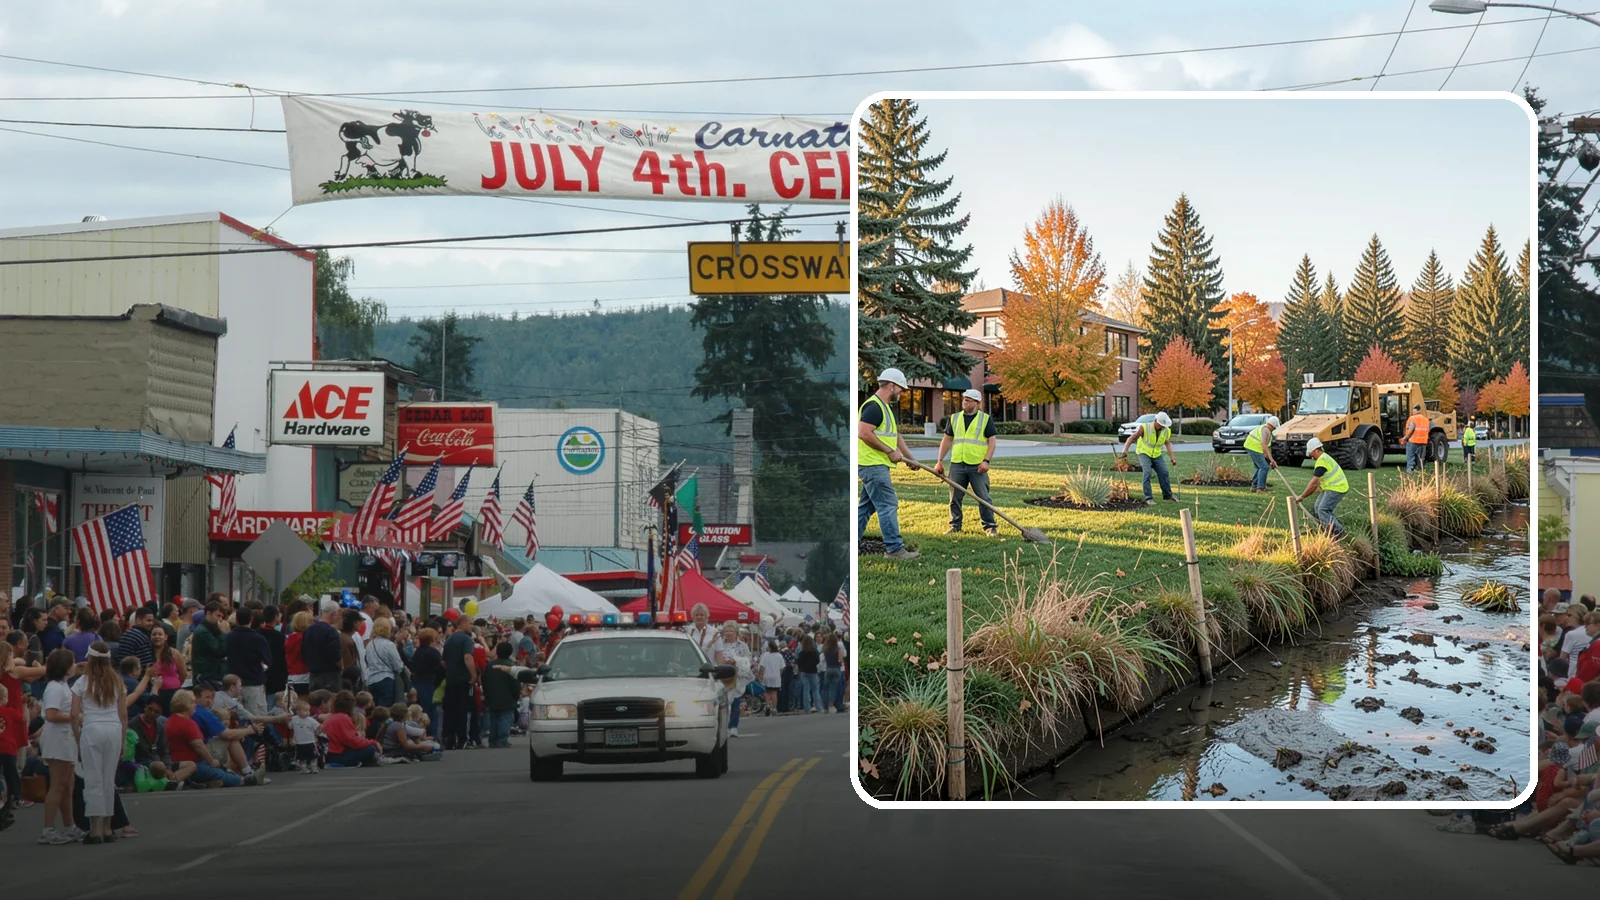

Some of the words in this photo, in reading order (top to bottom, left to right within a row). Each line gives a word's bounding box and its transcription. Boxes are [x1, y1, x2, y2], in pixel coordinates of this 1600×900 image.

[481, 141, 605, 192] JULY
[632, 150, 746, 197] 4th.
[696, 254, 850, 280] CROSSWA
[282, 380, 373, 420] ACE
[405, 409, 452, 422] CEDAR
[460, 409, 485, 422] LOG
[283, 421, 371, 436] Hardware
[416, 428, 477, 447] Coca-Cola
[353, 467, 386, 480] Simpl
[95, 485, 124, 494] Vincent
[126, 486, 136, 494] de
[137, 486, 155, 495] Paul
[81, 503, 153, 521] THT
[688, 526, 741, 535] CRNATION
[699, 535, 730, 543] GLASS
